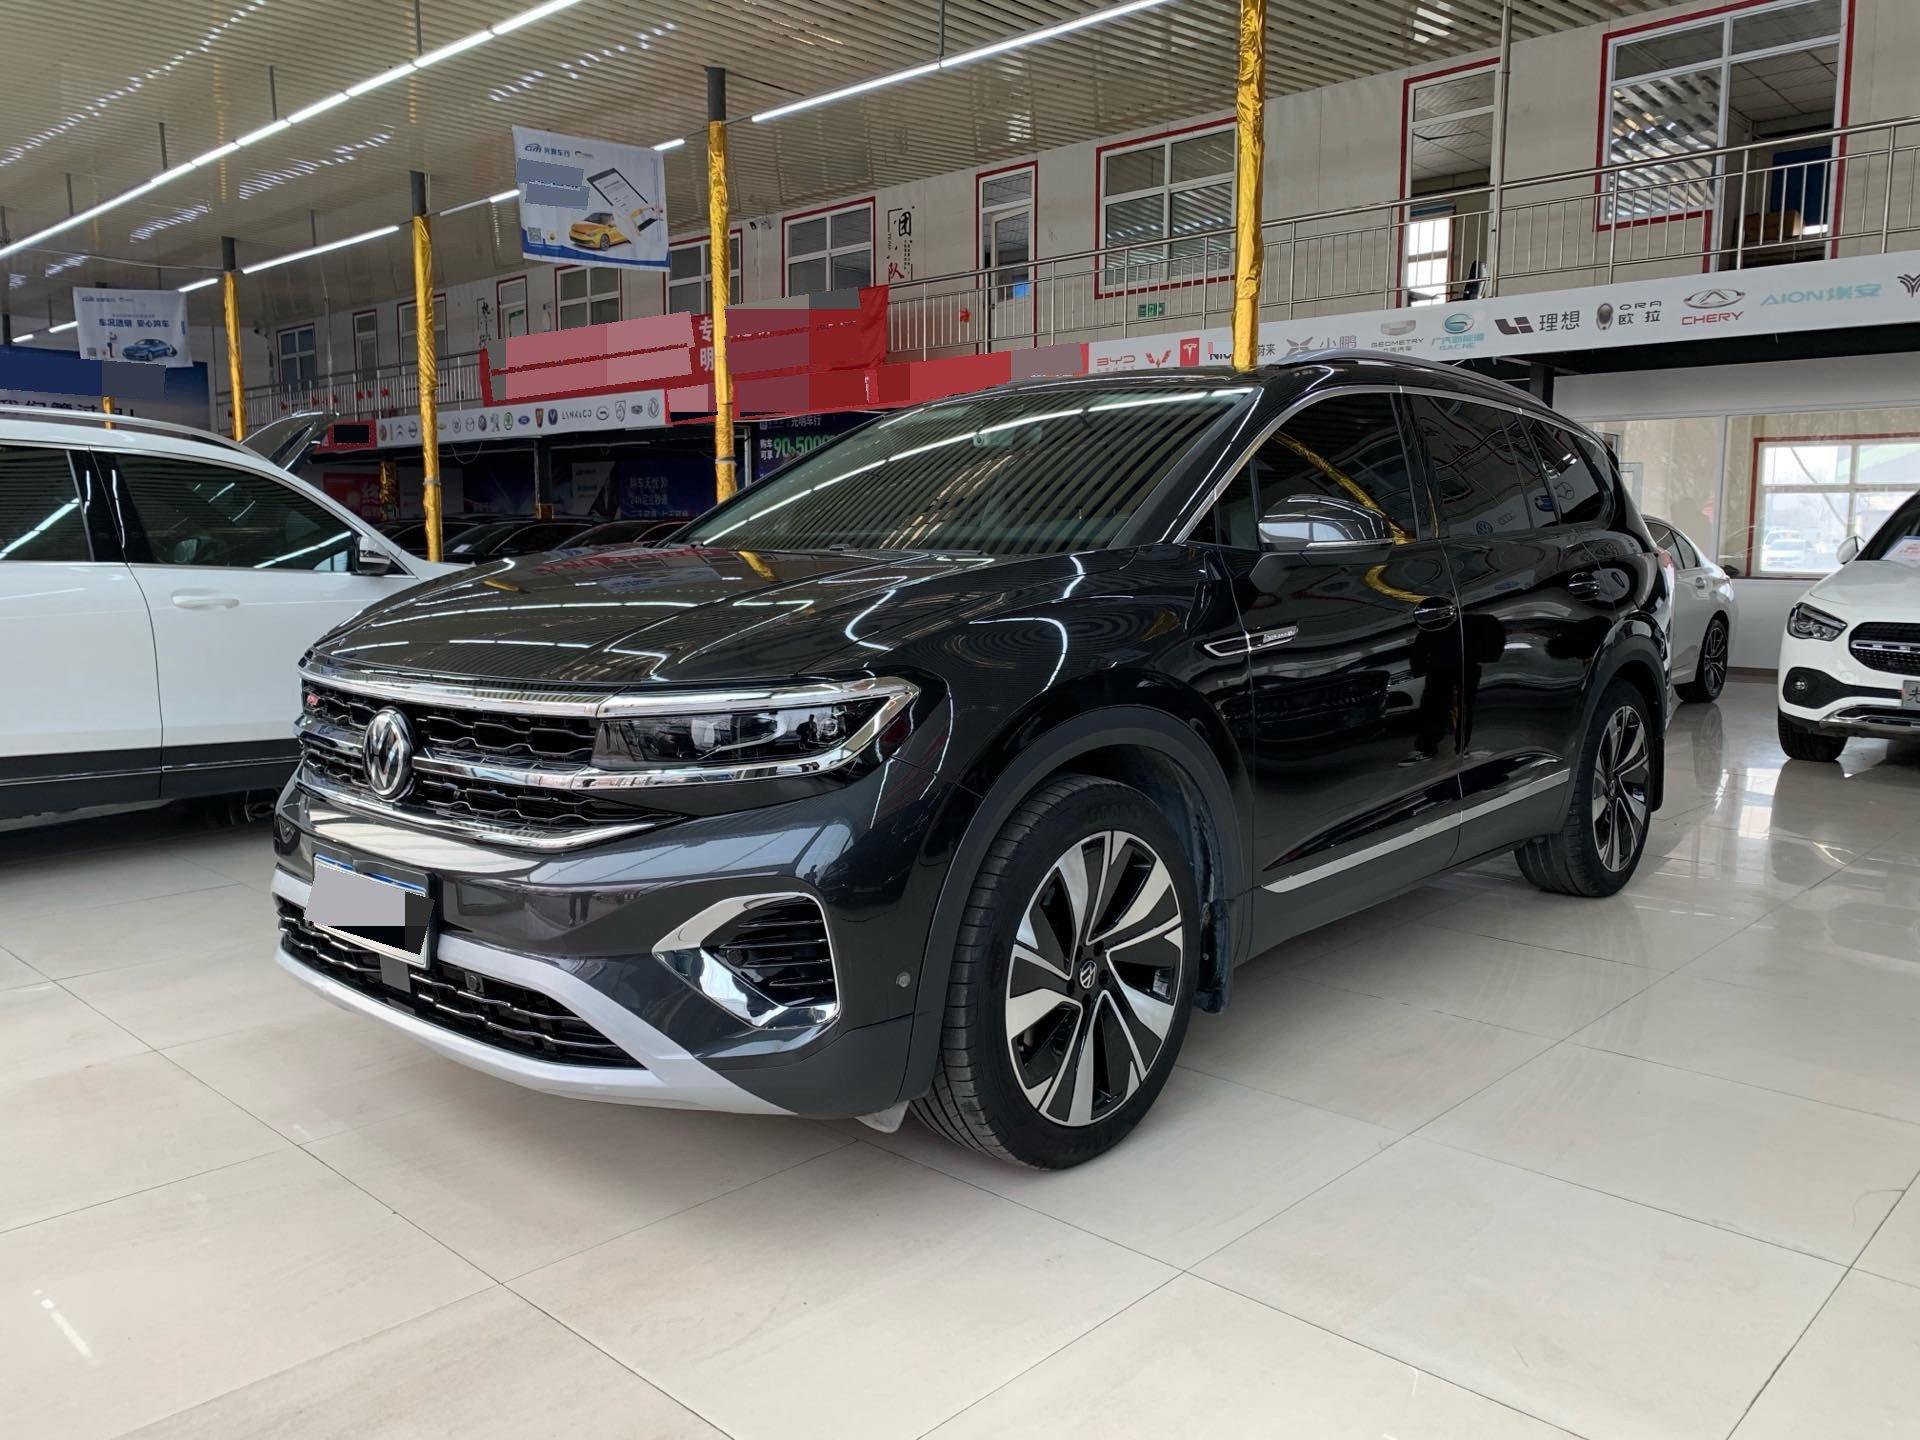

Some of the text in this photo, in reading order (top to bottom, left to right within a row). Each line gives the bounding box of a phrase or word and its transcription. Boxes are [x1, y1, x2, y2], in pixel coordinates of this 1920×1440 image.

[1619, 300, 1662, 311] ORA
[1538, 310, 1580, 332] 理想
[1618, 310, 1661, 326] 欧拉
[1681, 311, 1744, 326] CHERY
[1319, 335, 1358, 350] 小鹏
[1371, 338, 1424, 349] GEOMETRY
[1096, 354, 1136, 367] BYD
